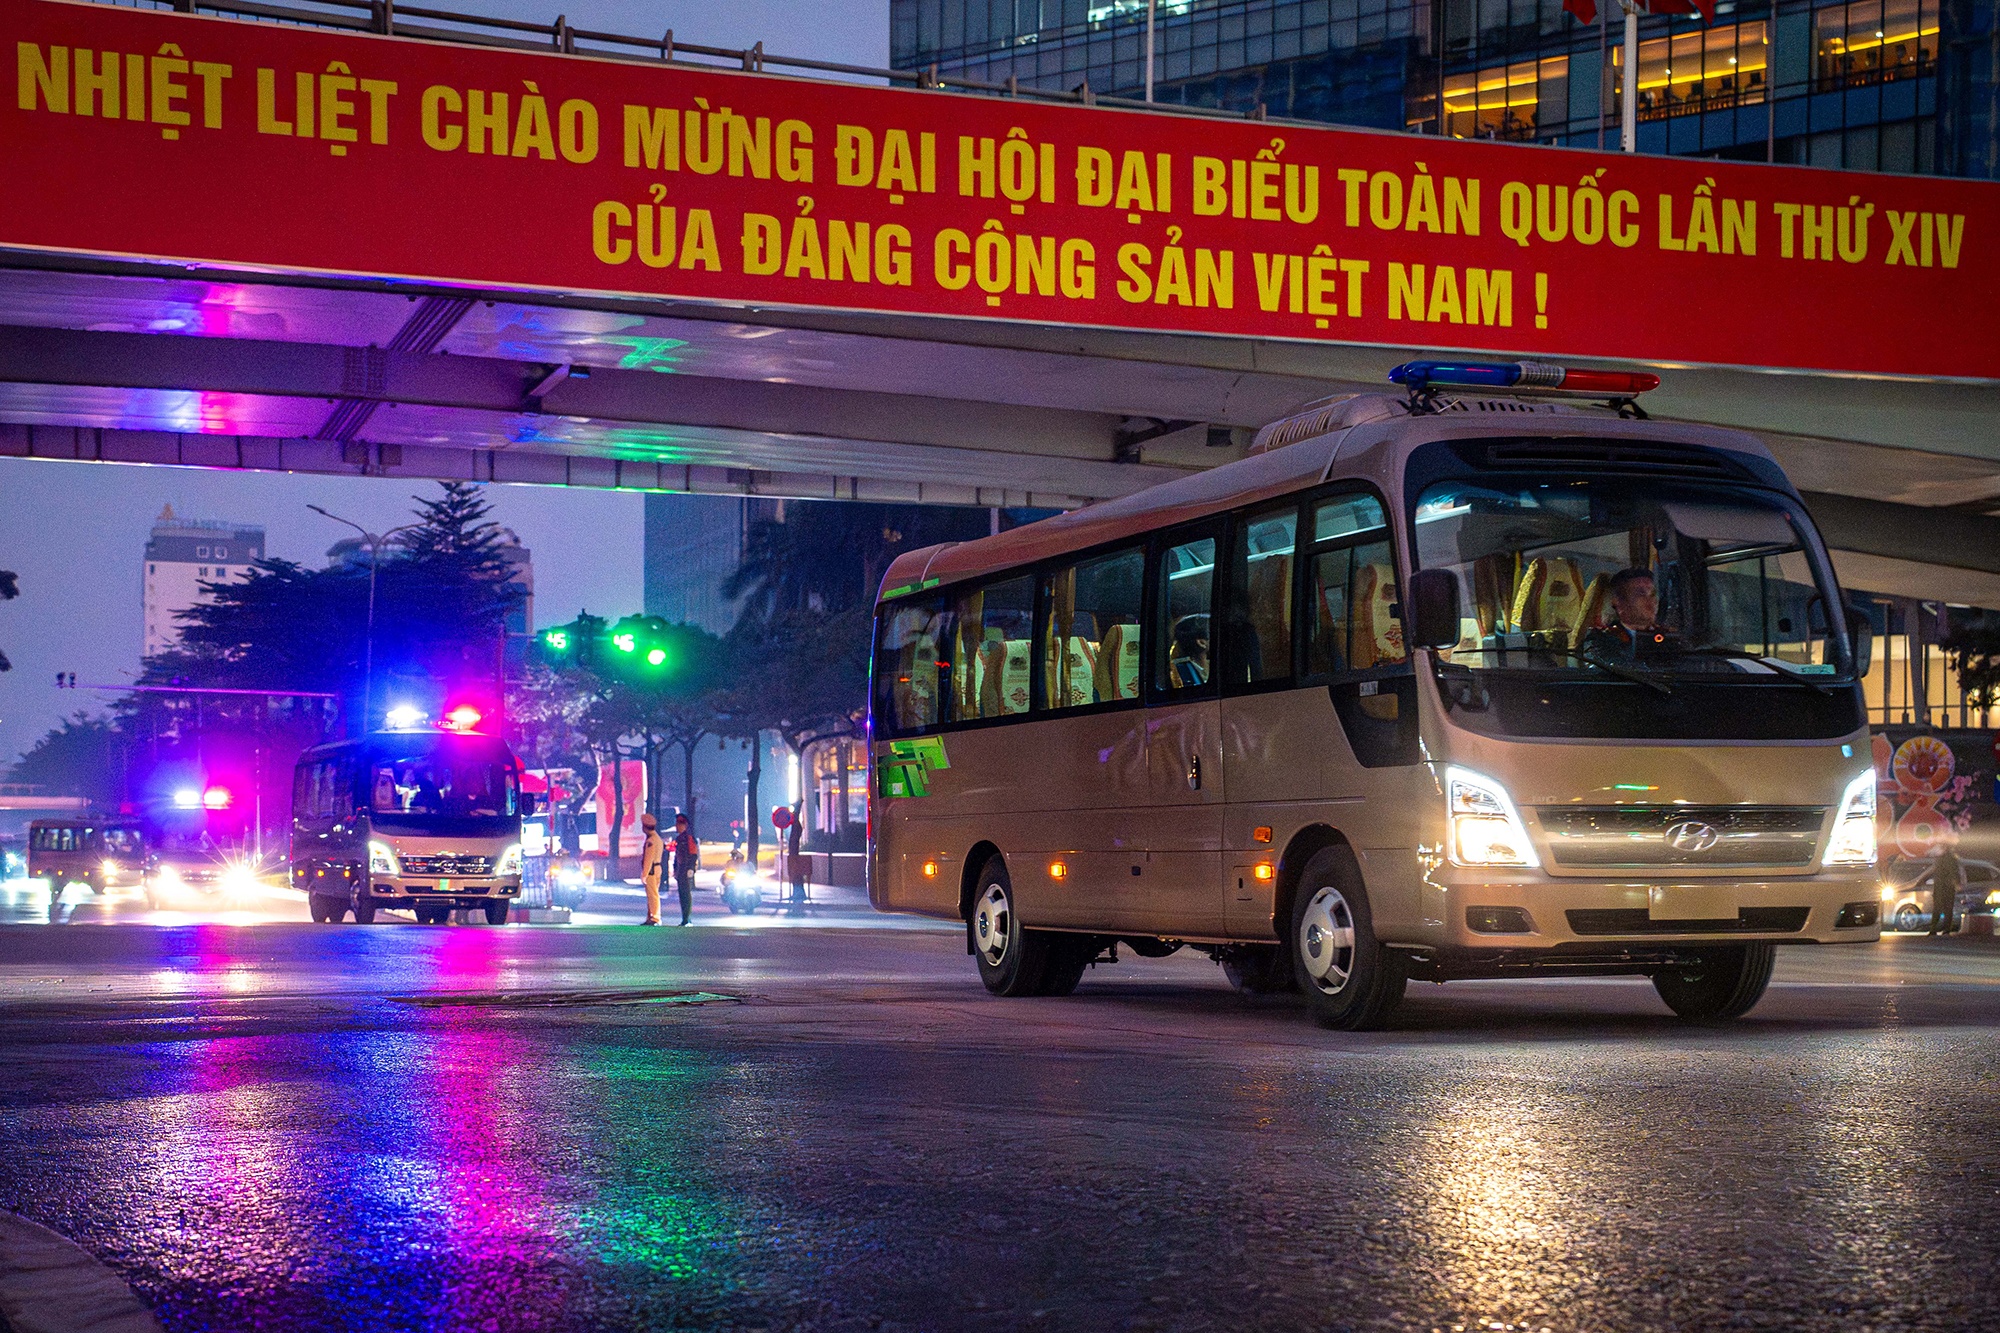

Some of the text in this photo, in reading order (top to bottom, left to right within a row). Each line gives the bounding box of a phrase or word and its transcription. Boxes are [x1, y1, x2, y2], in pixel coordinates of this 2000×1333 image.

[18, 43, 1966, 269] NHIỆT LIỆT CHÀO MỪNG ĐẠI HỘI ĐẠI BIỂU TOÀN QUỐC LẦN THỨ XIV
[592, 183, 1550, 331] CỦA ĐẢNG CỘNG SẢN VIỆT NAM !
